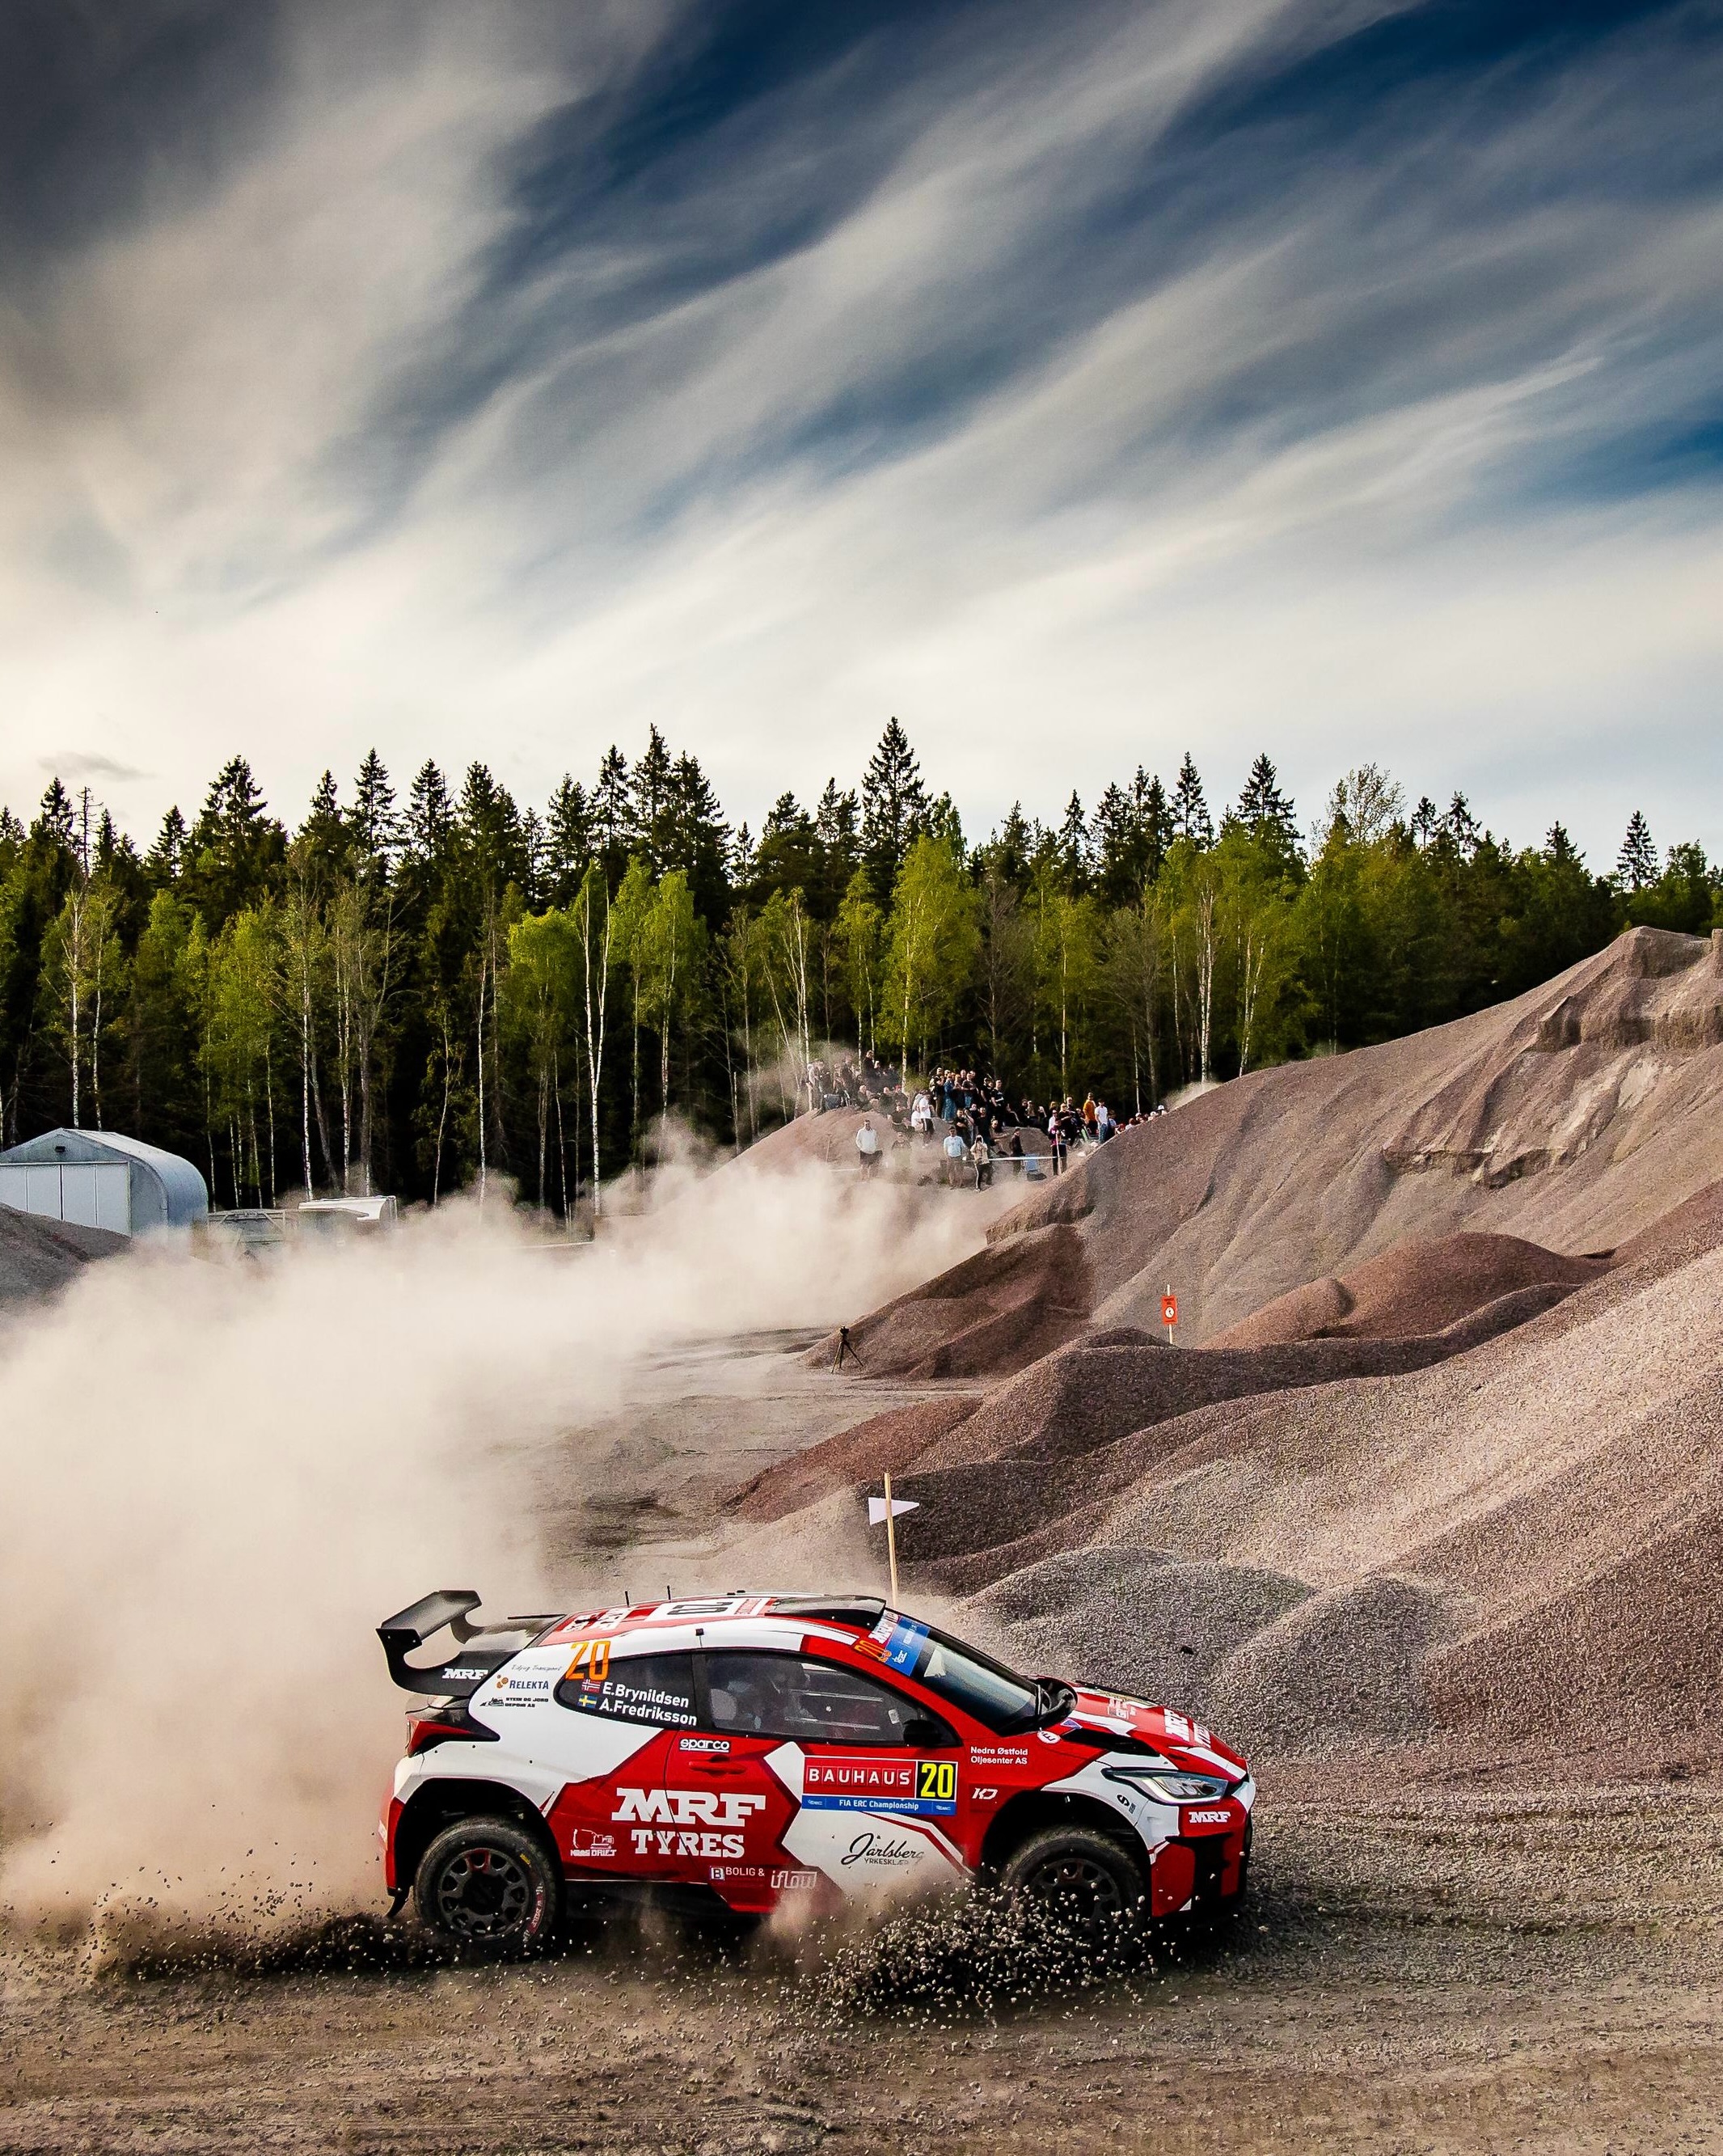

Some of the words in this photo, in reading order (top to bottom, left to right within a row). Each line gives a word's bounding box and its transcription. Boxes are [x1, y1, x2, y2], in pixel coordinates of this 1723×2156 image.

[565, 1640, 611, 1681] 20
[441, 1668, 489, 1680] MRF
[509, 1680, 549, 1690] RELEKTA
[602, 1681, 690, 1708] E.Brynildsen
[599, 1697, 697, 1726] A.Fredriksson
[680, 1739, 730, 1752] sparco
[970, 1746, 995, 1754] Nedre
[970, 1756, 1013, 1765] Oljesenter
[1016, 1757, 1028, 1765] AS
[809, 1768, 910, 1786] BAUHAUS
[921, 1763, 953, 1798] 20
[611, 1787, 766, 1827] MRF
[869, 1800, 919, 1811] Championship
[1189, 1811, 1231, 1823] MRF
[631, 1829, 745, 1858] TYRES
[841, 1833, 924, 1865] Jarlsberg
[725, 1867, 756, 1876] BOLIG
[758, 1868, 766, 1876] &
